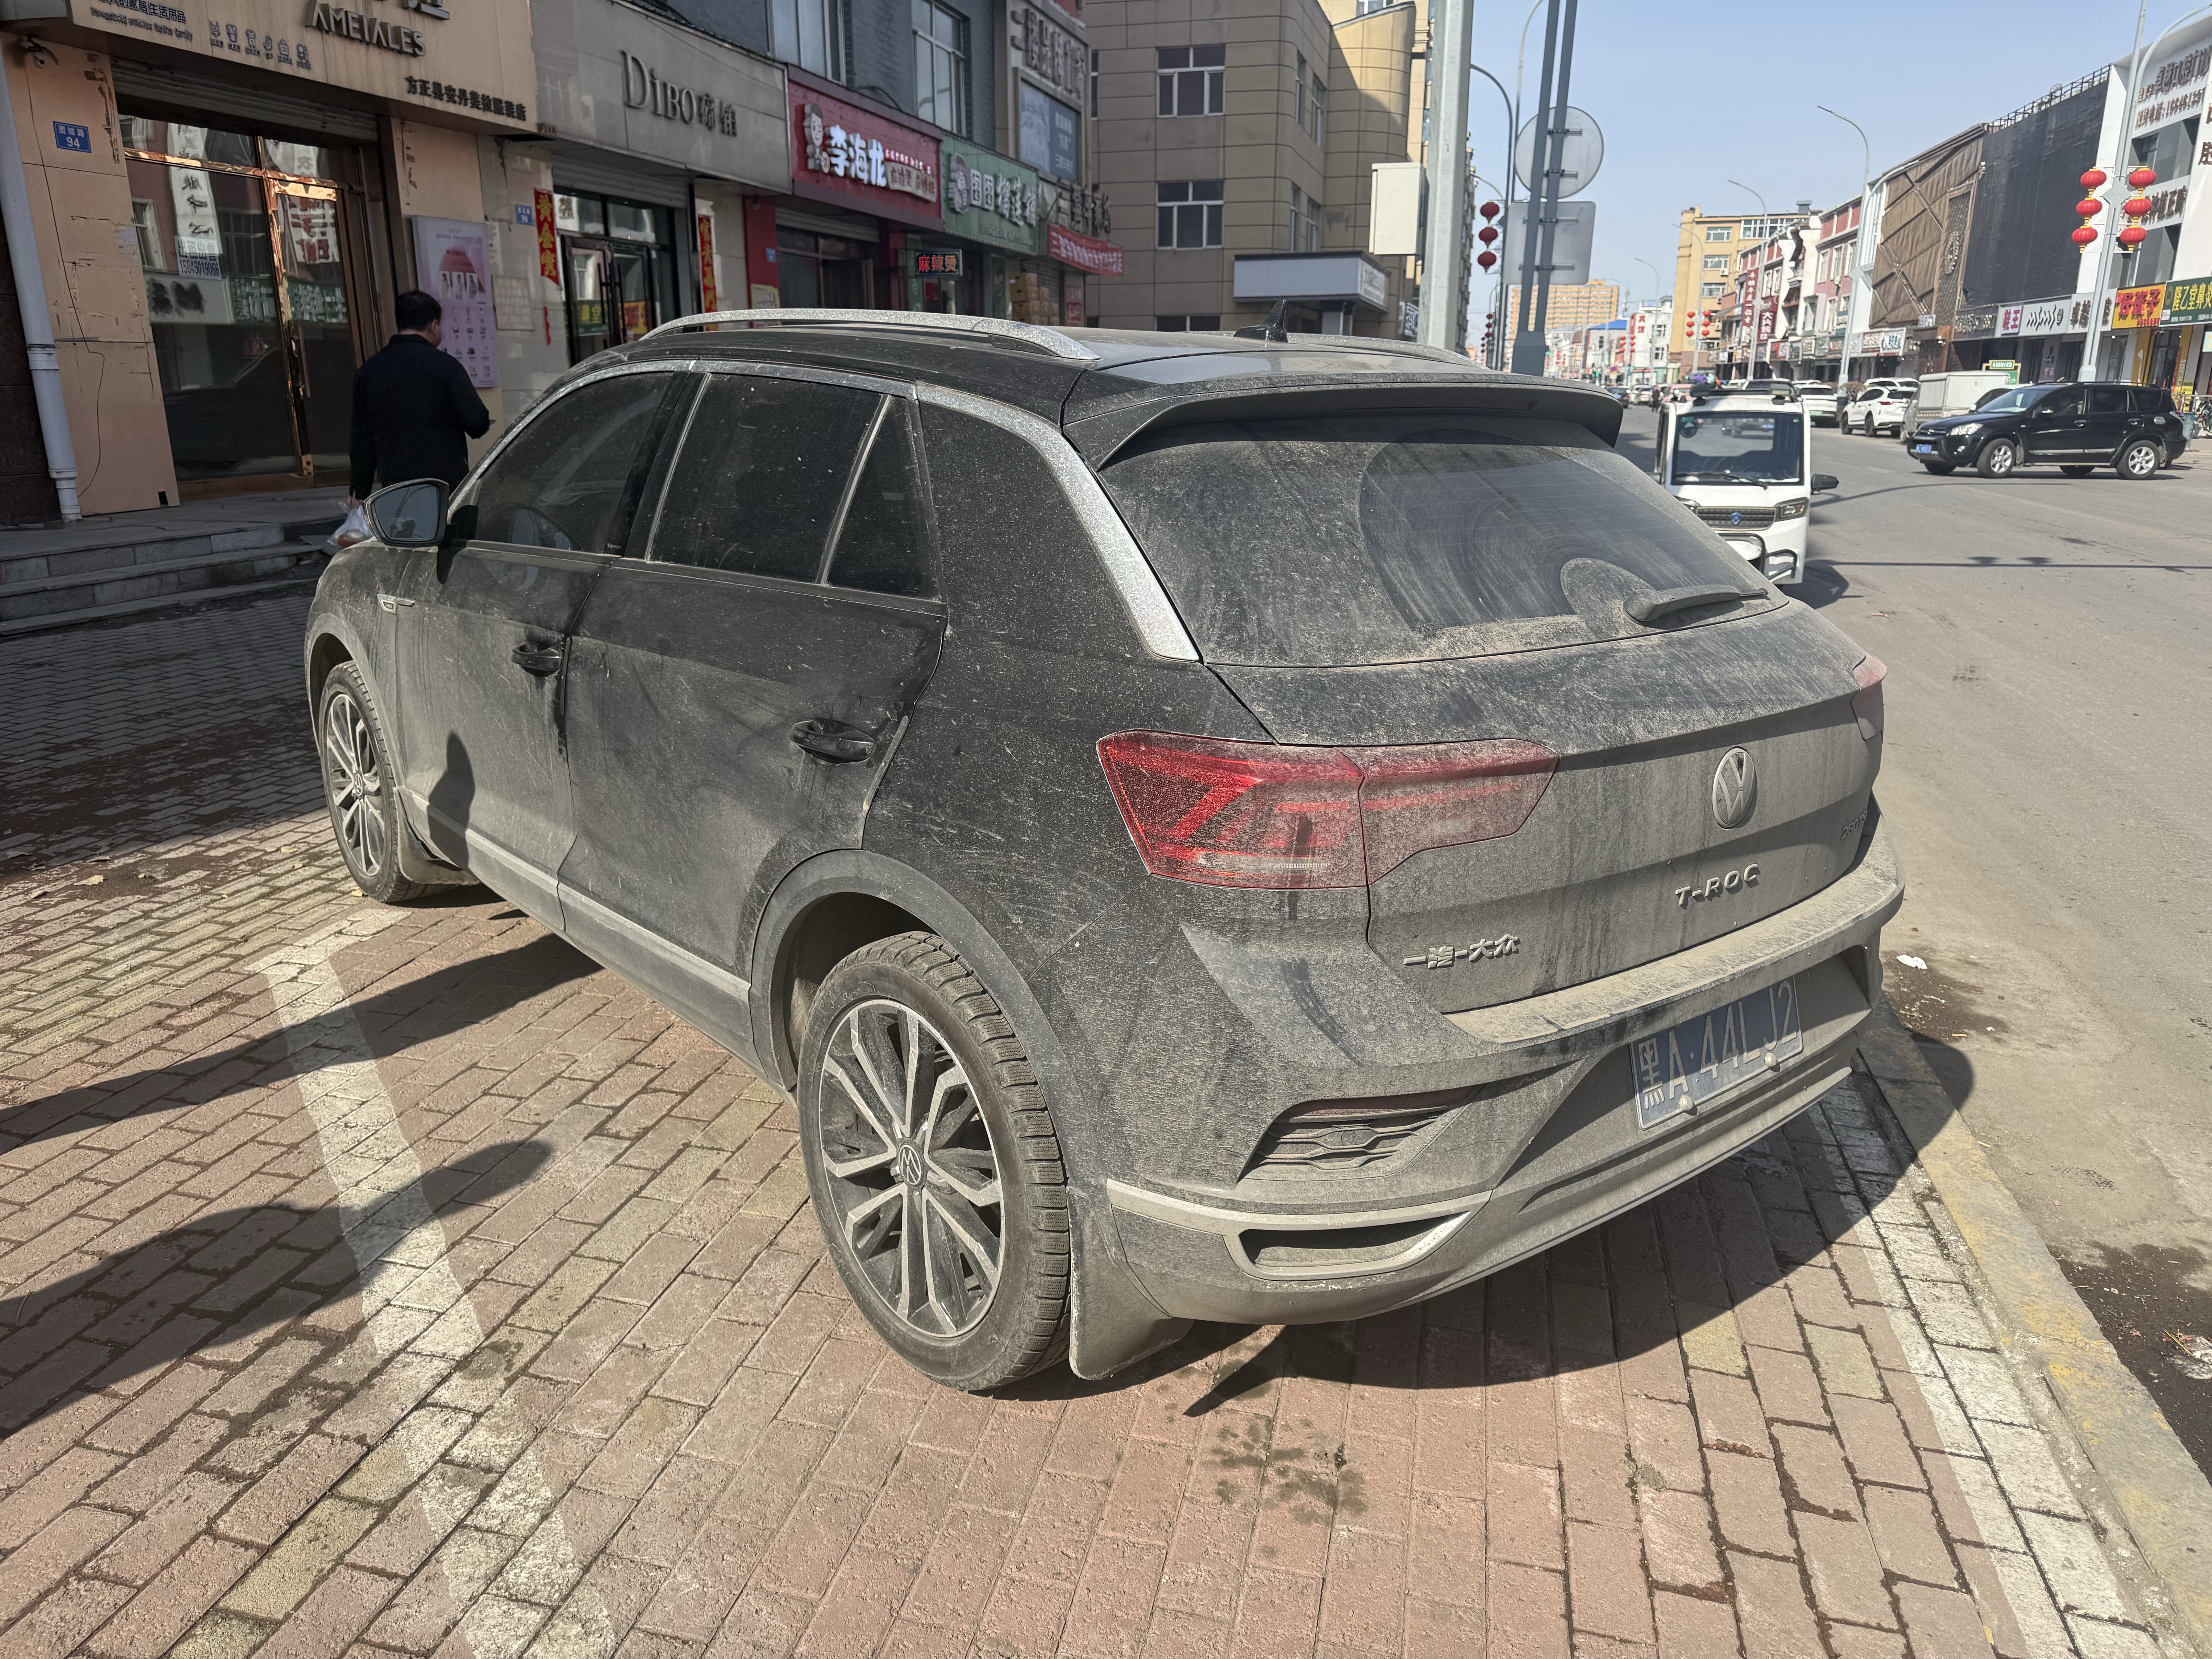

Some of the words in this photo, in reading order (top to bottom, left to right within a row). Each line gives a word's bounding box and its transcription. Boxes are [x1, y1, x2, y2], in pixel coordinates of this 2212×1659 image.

[66, 137, 81, 148] 94
[918, 255, 957, 272] 麻辣烫
[1675, 863, 1759, 905] T-ROC
